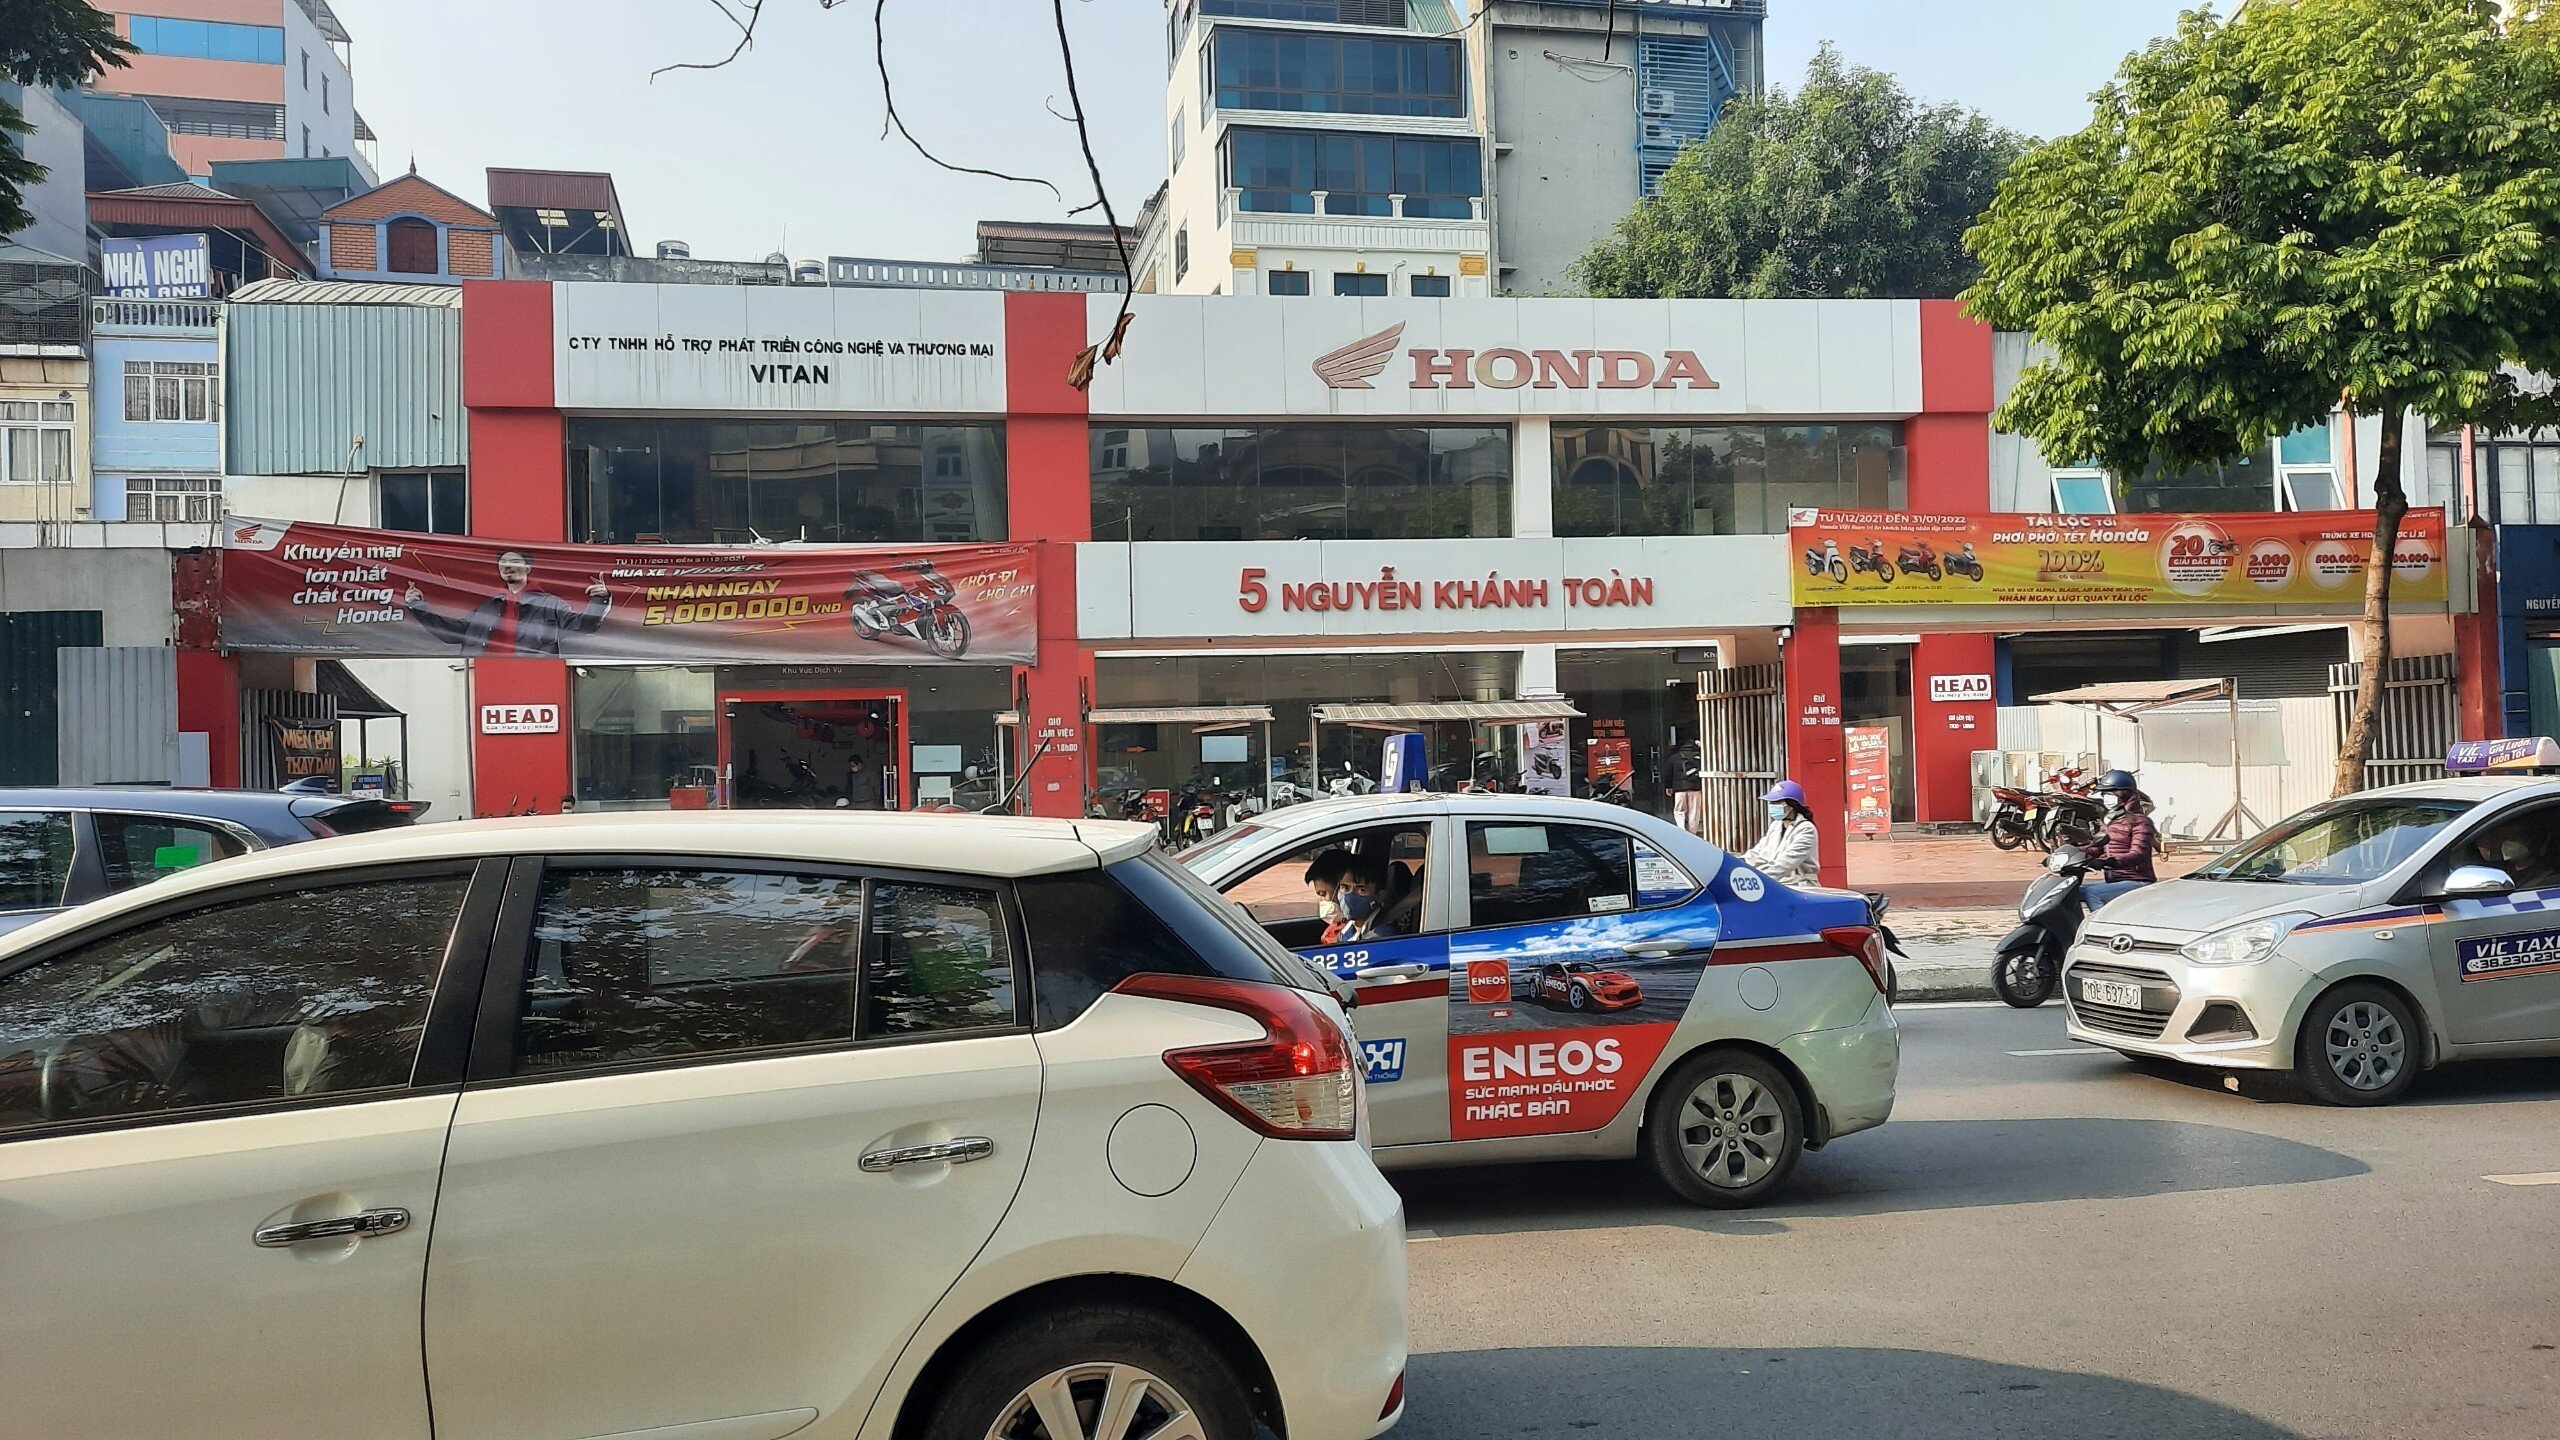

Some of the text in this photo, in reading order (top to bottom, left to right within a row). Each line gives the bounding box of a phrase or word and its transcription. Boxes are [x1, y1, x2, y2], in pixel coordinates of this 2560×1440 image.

[103, 236, 205, 287] NHÀ NGHỈ
[158, 285, 201, 297] ANH
[608, 337, 648, 351] TNHH
[654, 333, 675, 352] HỖ
[682, 338, 713, 356] TRỢ
[718, 337, 756, 354] PHÁT
[760, 333, 800, 354] TRIỂN
[804, 337, 843, 354] CÔNG
[847, 338, 884, 357] NGHỆ
[907, 341, 967, 357] THƯƠNG
[969, 343, 994, 358] MẠI
[750, 364, 830, 385] VITAN
[1408, 347, 1720, 389] HONDA
[1818, 511, 1967, 524] TỪ 1/12/2021 ĐẾN 31/01/2022
[2025, 513, 2117, 530] TÀI LỘC TỚI
[1992, 528, 2150, 543] PHƠI PHỚI TẾT Honda
[2349, 531, 2360, 539] XE
[283, 541, 405, 564] Khuyến mại
[2171, 535, 2205, 556] 20
[2037, 550, 2105, 572] 100%
[2248, 554, 2291, 567] 2.000
[2393, 553, 2430, 563] 00.000
[305, 564, 389, 584] lớn nhất
[611, 568, 643, 578] MUA
[646, 568, 668, 577] XE
[957, 569, 998, 590] CHỐT
[292, 585, 394, 606] chất cùng
[646, 579, 783, 603] NHẬN NGAY
[1237, 565, 1655, 613] 5 NGUYỄN KHÁNH TOÀN
[336, 606, 405, 625] Honda
[643, 596, 810, 626] 5.000.000
[1934, 678, 1988, 693] HEAD
[486, 708, 554, 725] HEAD
[314, 725, 334, 750] PHÍ
[1057, 728, 1075, 739] VIỆC
[2457, 756, 2477, 764] TAXI
[1731, 877, 1760, 892] 1238
[1343, 950, 1369, 969] 32
[1471, 976, 1507, 986] ENEOS
[1545, 978, 1567, 992] ENEOS
[1365, 1041, 1403, 1070] XI
[1462, 1037, 1624, 1082] ENEOS
[1465, 1081, 1497, 1101] SỨC
[1498, 1083, 1540, 1101] MẠNH
[1465, 1096, 1570, 1122] NHẬT BẢN
